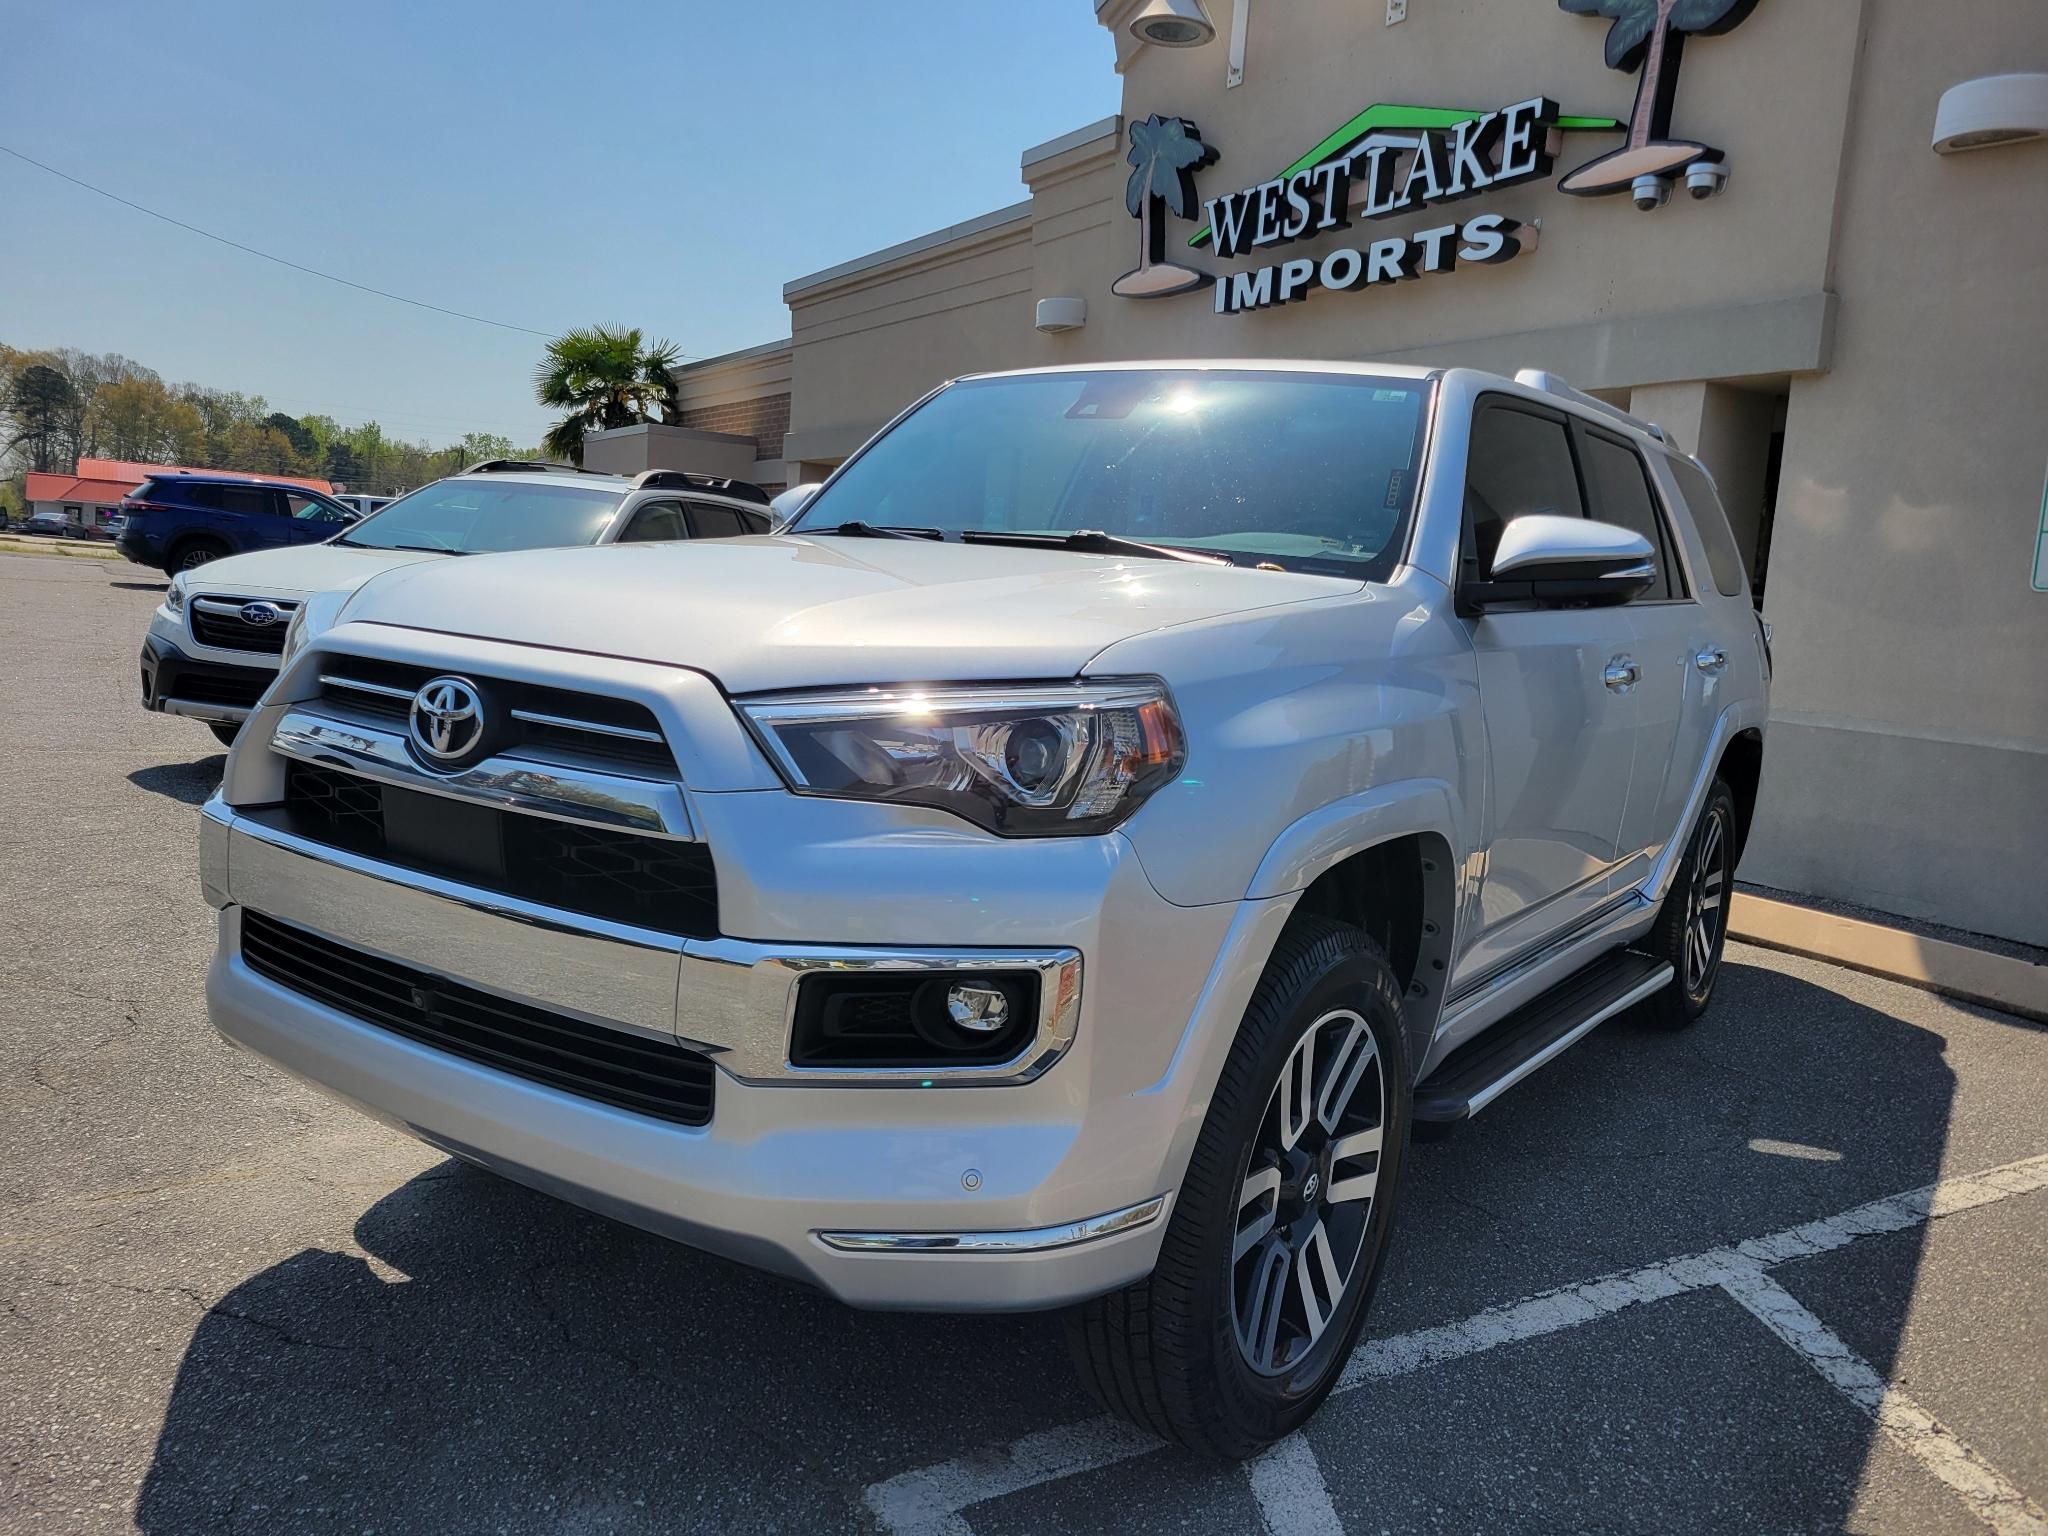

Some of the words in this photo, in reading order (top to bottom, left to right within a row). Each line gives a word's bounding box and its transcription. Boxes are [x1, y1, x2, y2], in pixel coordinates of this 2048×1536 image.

[1203, 157, 1351, 257] WEST
[1360, 96, 1544, 218] LAKE
[1213, 213, 1505, 314] IMPORTS
